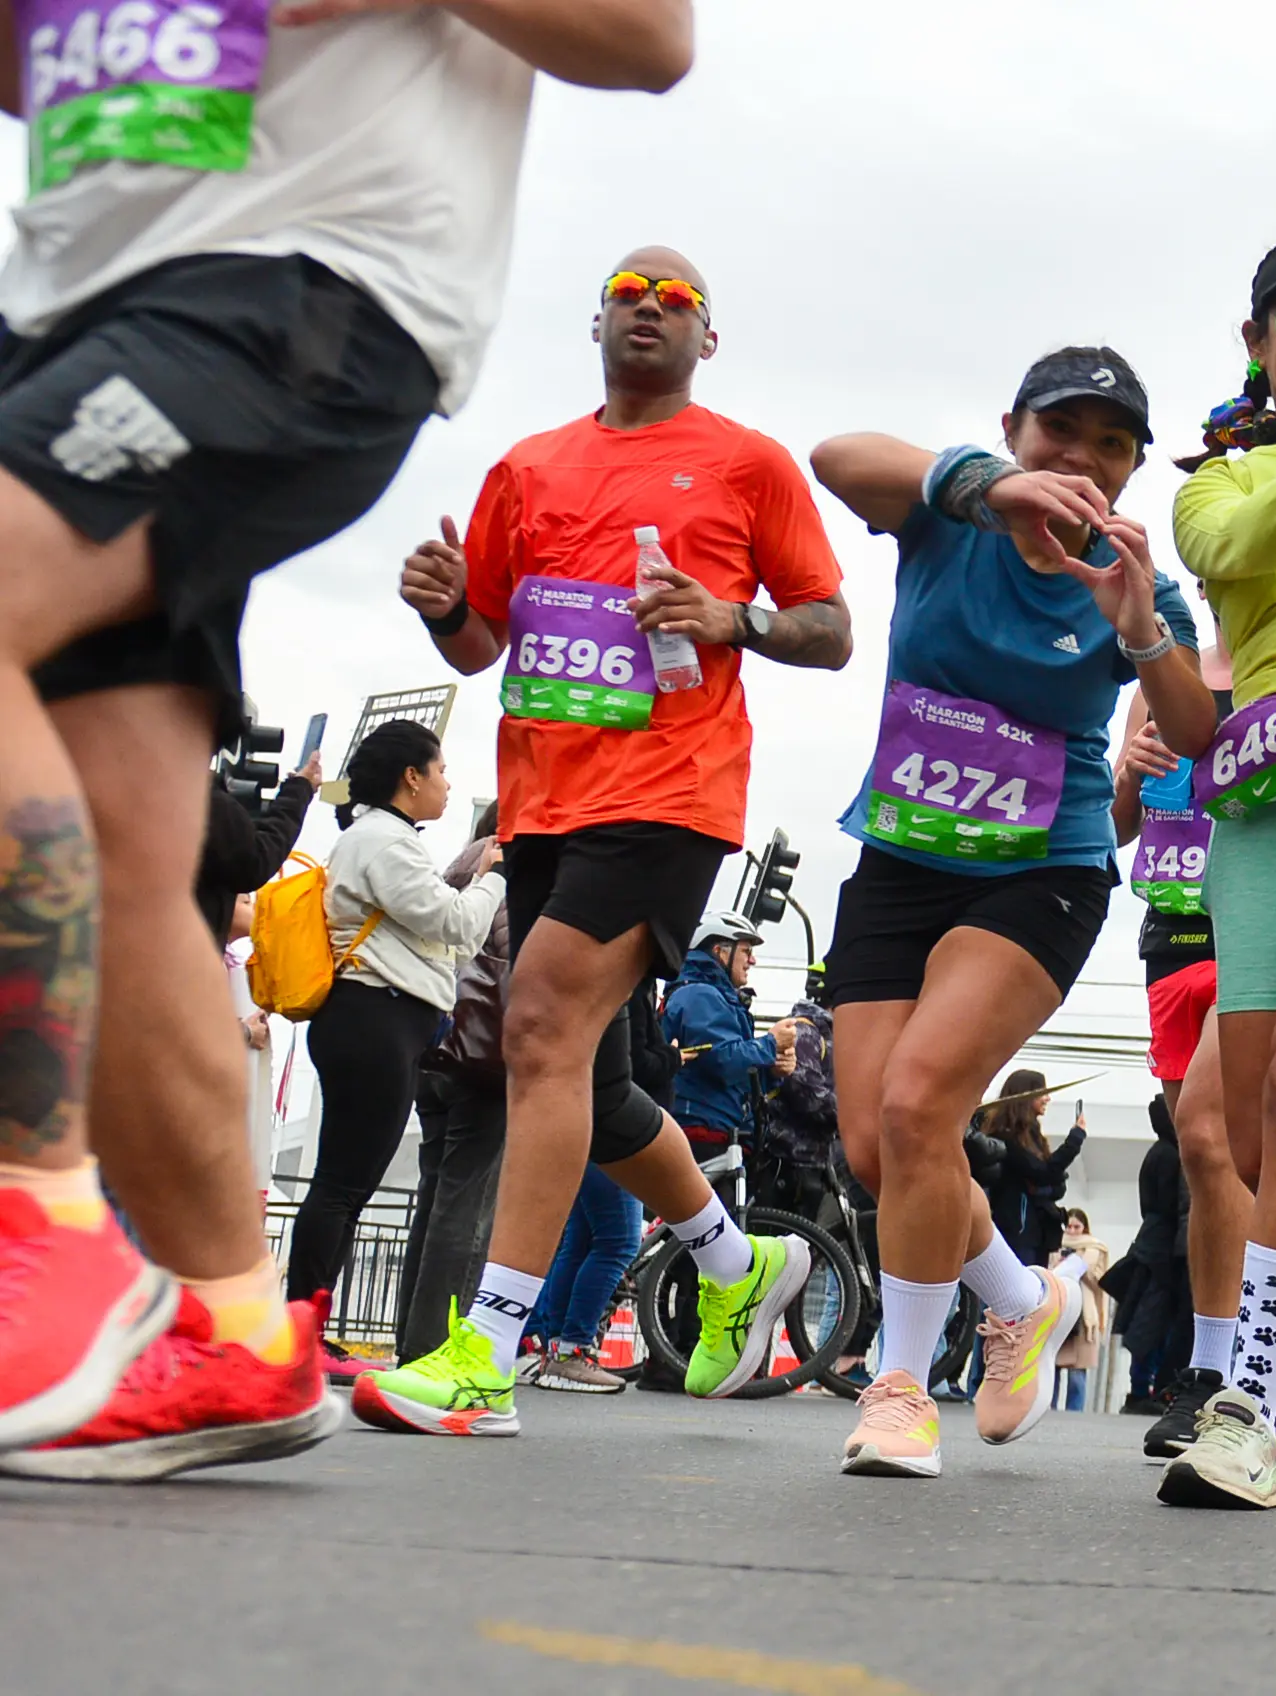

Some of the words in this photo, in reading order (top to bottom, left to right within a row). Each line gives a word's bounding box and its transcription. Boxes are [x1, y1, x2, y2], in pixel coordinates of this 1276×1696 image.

[602, 597, 633, 615] 42
[518, 632, 636, 685] 6396
[927, 704, 986, 726] MARATÓN
[938, 717, 984, 734] SANTIAGO
[996, 722, 1034, 746] 42K
[891, 752, 1028, 821] 4274
